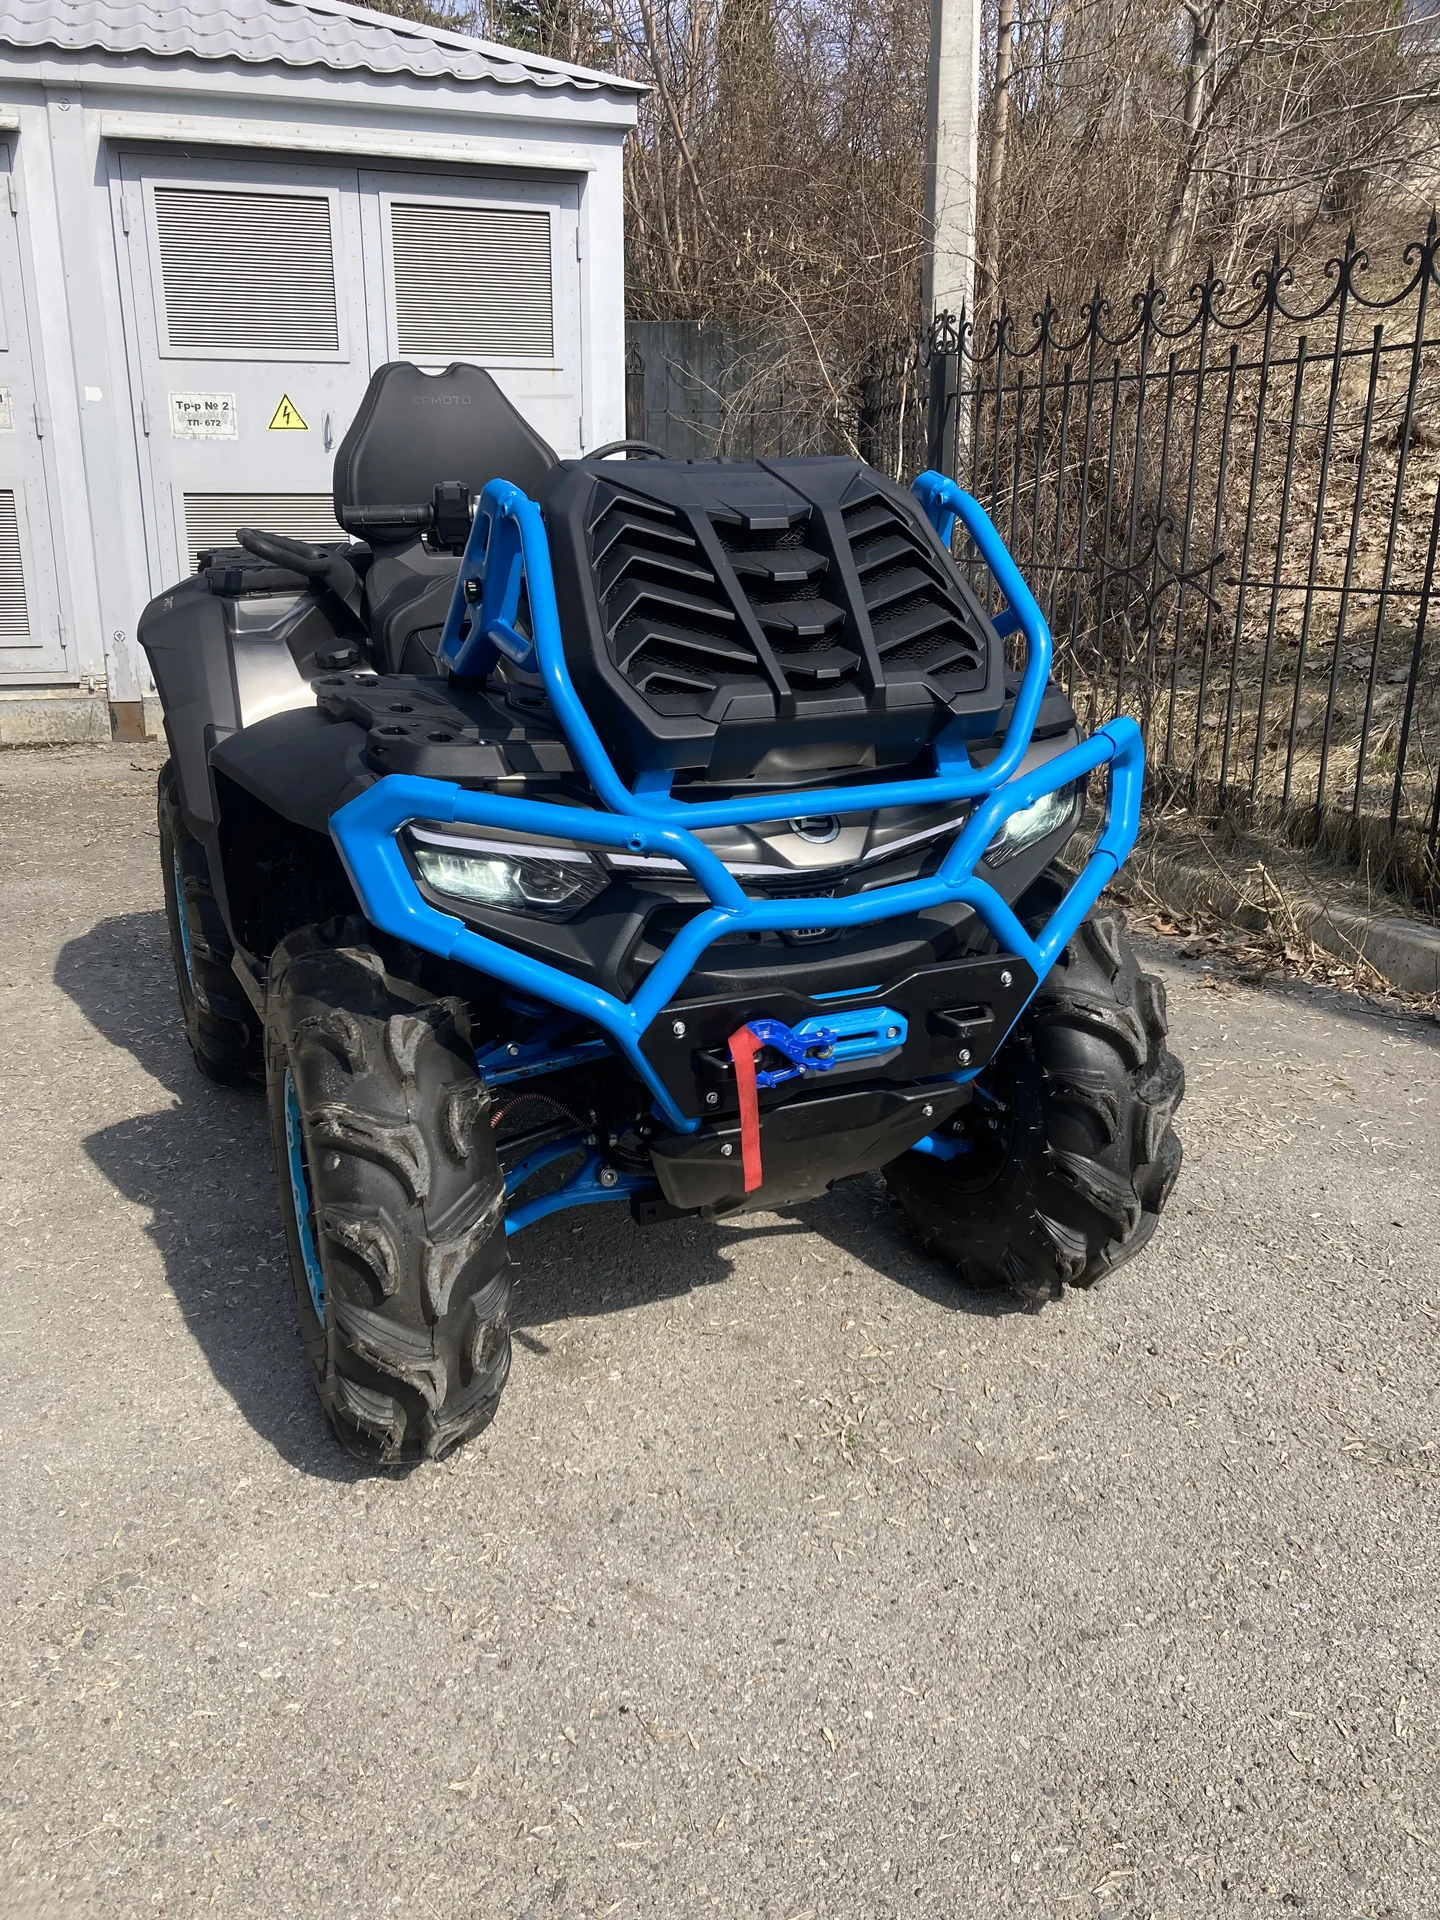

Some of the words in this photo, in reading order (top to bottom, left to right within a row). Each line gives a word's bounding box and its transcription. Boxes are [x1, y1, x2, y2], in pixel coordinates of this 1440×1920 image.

[176, 401, 201, 411] Тр-р
[205, 401, 219, 410] №
[222, 402, 230, 410] 2
[412, 396, 472, 406] CFMOTO
